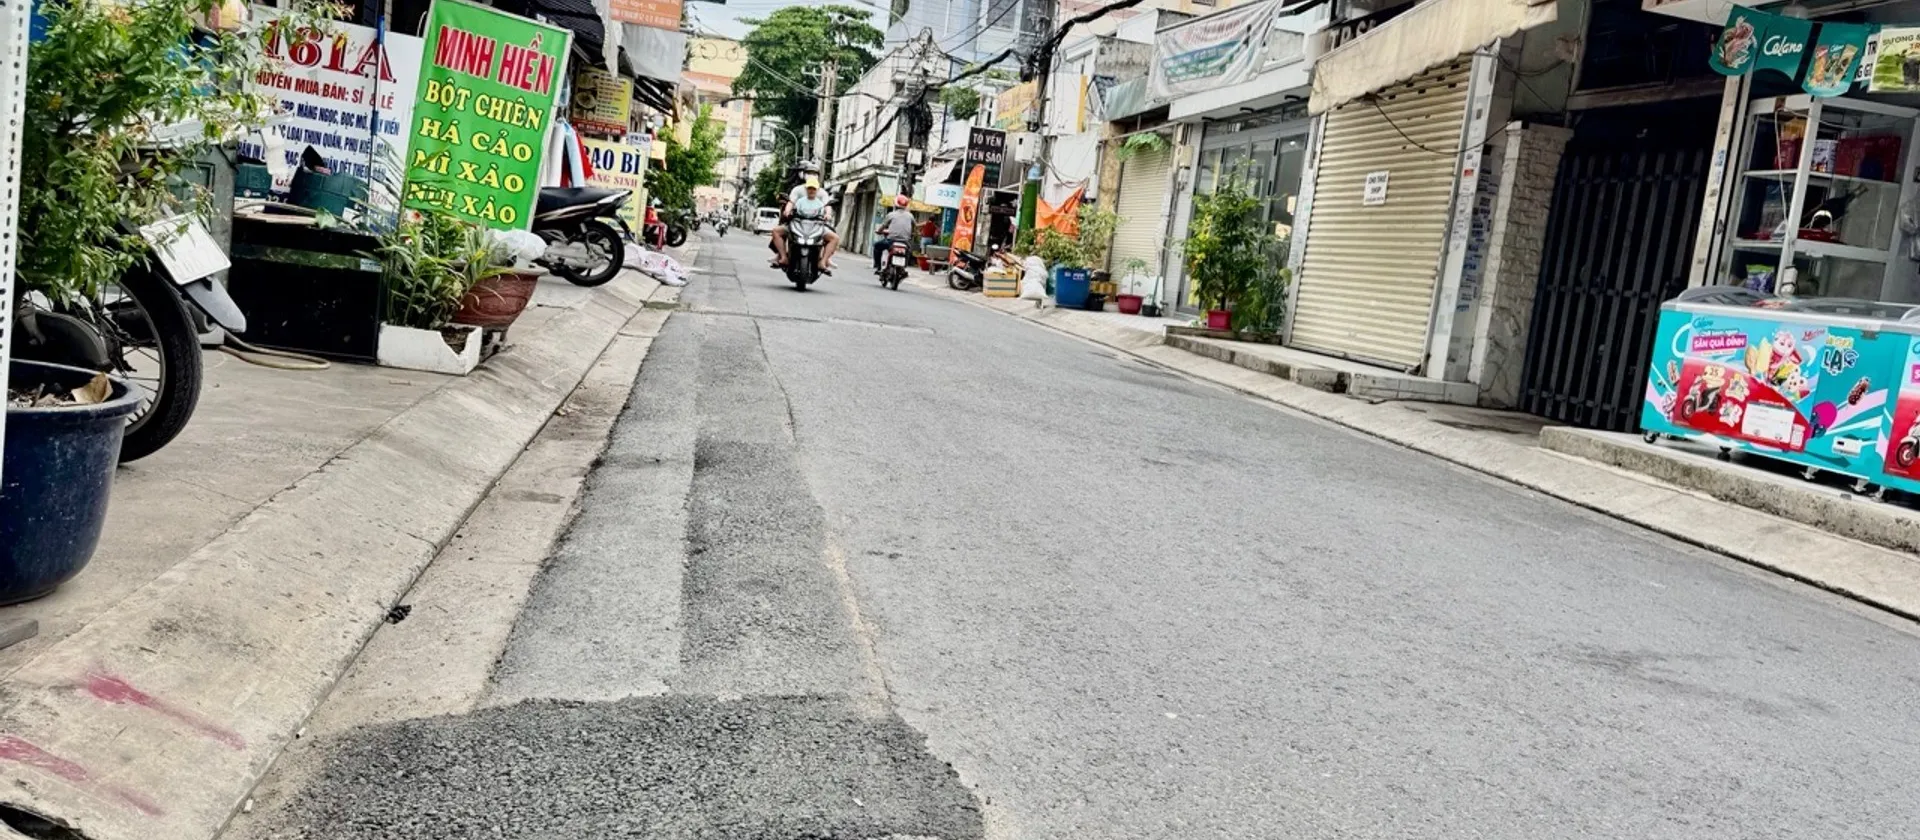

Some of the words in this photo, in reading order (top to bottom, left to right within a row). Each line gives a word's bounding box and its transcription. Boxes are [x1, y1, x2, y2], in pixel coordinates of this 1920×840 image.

[263, 19, 397, 83] 181A
[434, 25, 496, 79] MINH
[498, 32, 555, 95] HIỀN
[1763, 35, 1803, 56] Celano
[255, 71, 292, 90] HUYÊN
[294, 79, 319, 97] MUA
[321, 82, 349, 101] BÁN:
[425, 77, 471, 113] BỘT
[475, 93, 543, 131] CHIÊN
[359, 138, 371, 157] KIỆ
[419, 117, 461, 145] HÁ
[470, 130, 533, 162] CẢO
[412, 149, 452, 175] MÌ
[456, 160, 524, 193] XÀO
[620, 149, 641, 174] BÌ
[461, 194, 516, 224] XÀO
